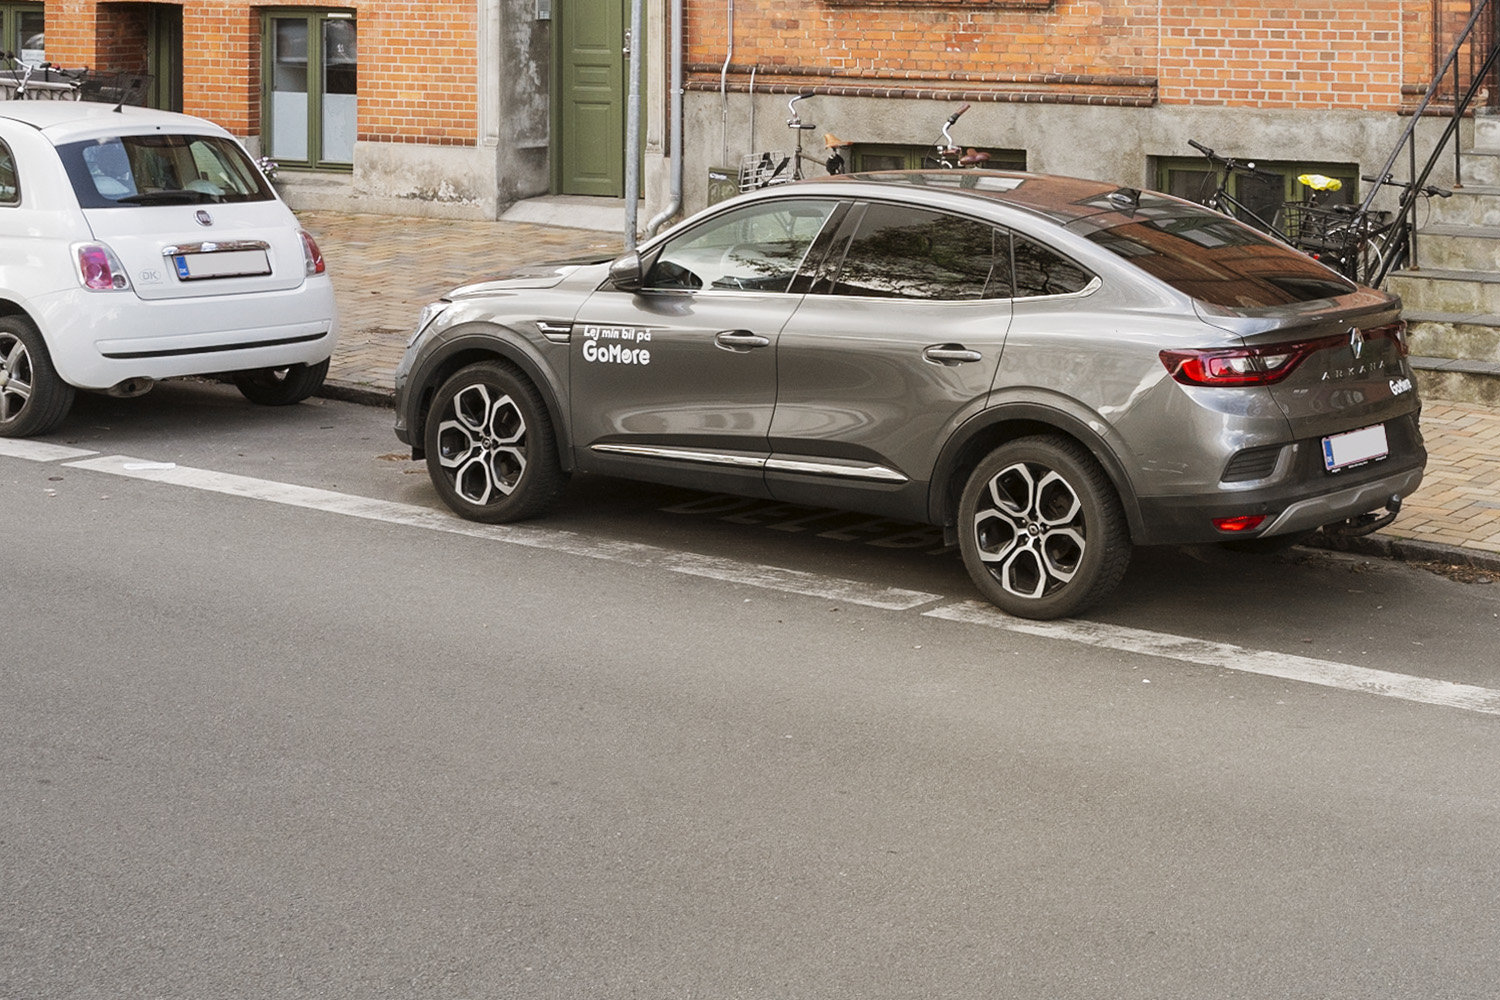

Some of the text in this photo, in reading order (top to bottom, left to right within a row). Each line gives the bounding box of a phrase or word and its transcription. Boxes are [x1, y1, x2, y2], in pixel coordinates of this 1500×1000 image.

[142, 271, 159, 280] DK
[583, 325, 652, 344] Lej min bil på
[582, 340, 651, 365] GoMore
[1321, 360, 1386, 380] ARKANA
